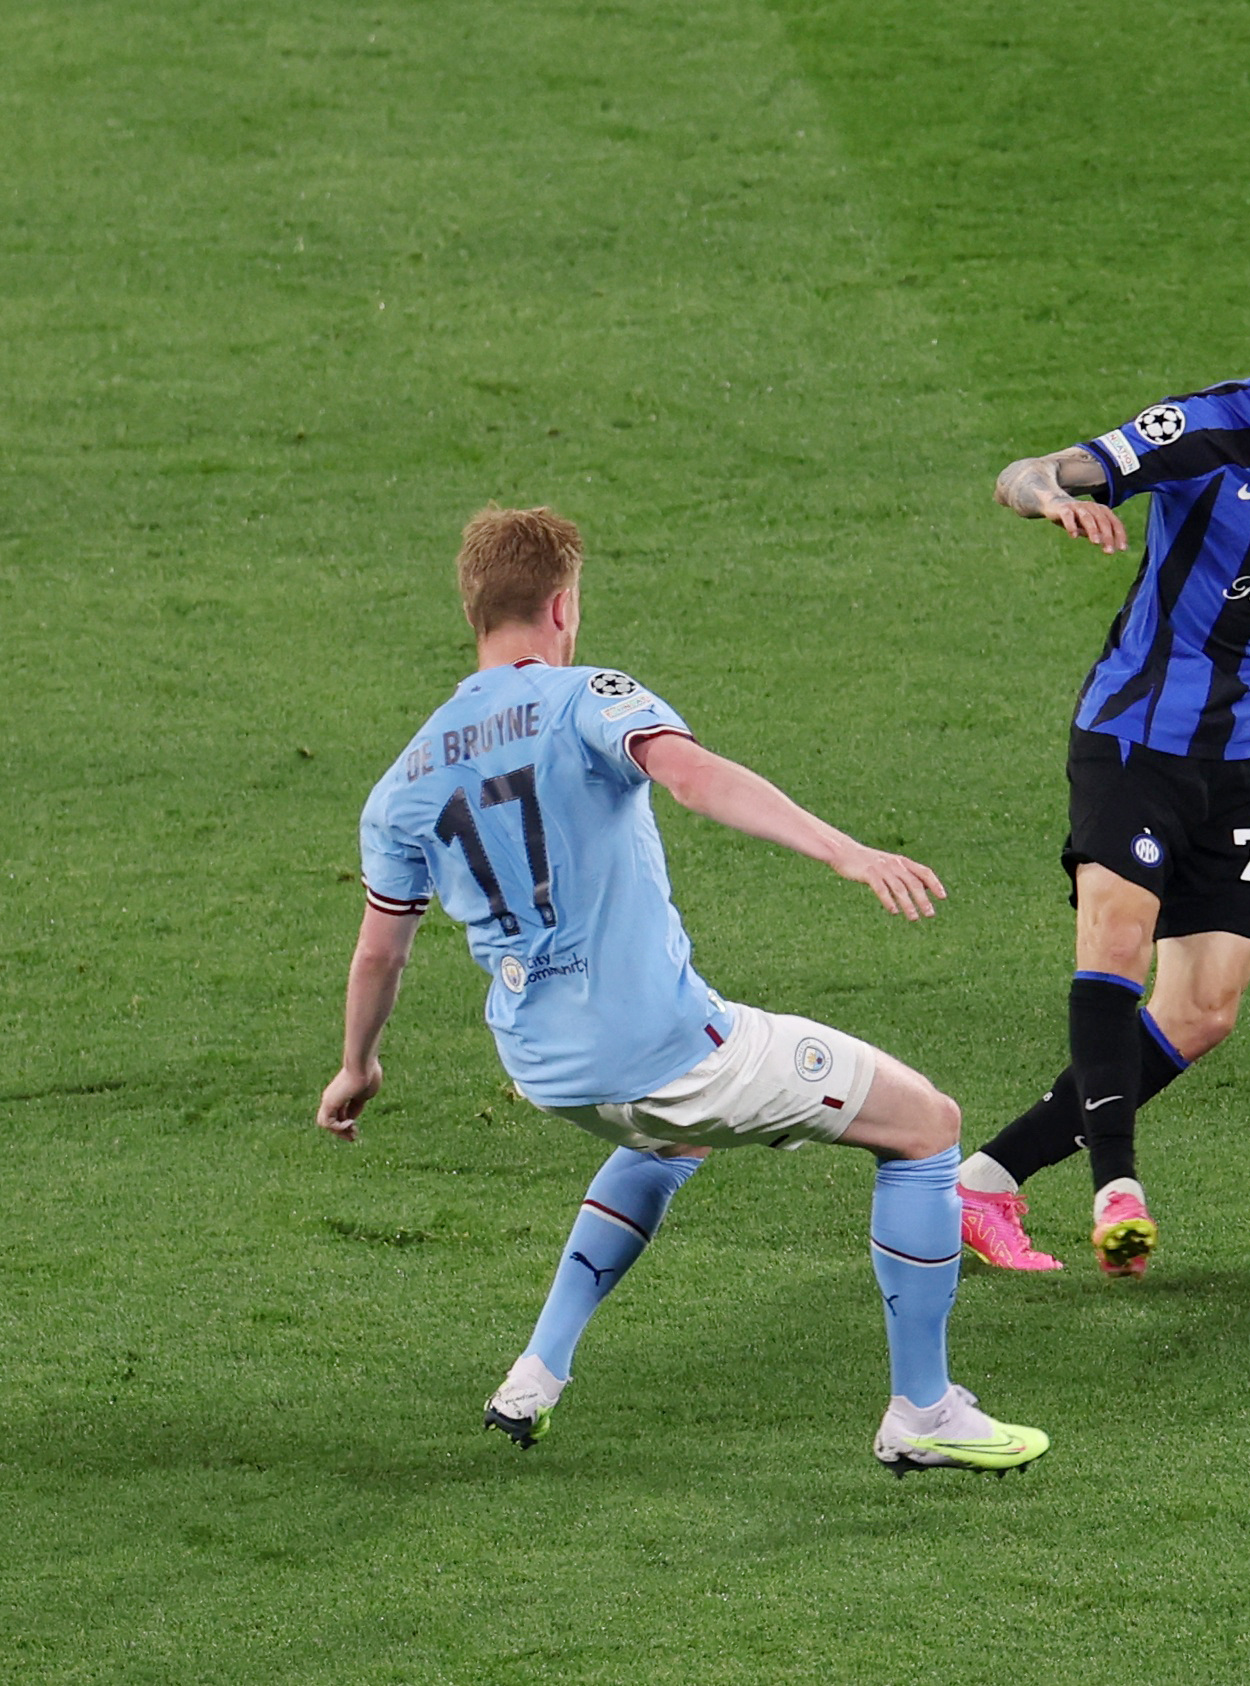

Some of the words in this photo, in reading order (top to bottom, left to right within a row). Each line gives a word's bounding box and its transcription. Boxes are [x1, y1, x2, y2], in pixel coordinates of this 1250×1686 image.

[406, 739, 434, 783] DE
[442, 701, 540, 766] BRUYNE
[433, 763, 557, 937] 17
[523, 952, 589, 987] ommunity
